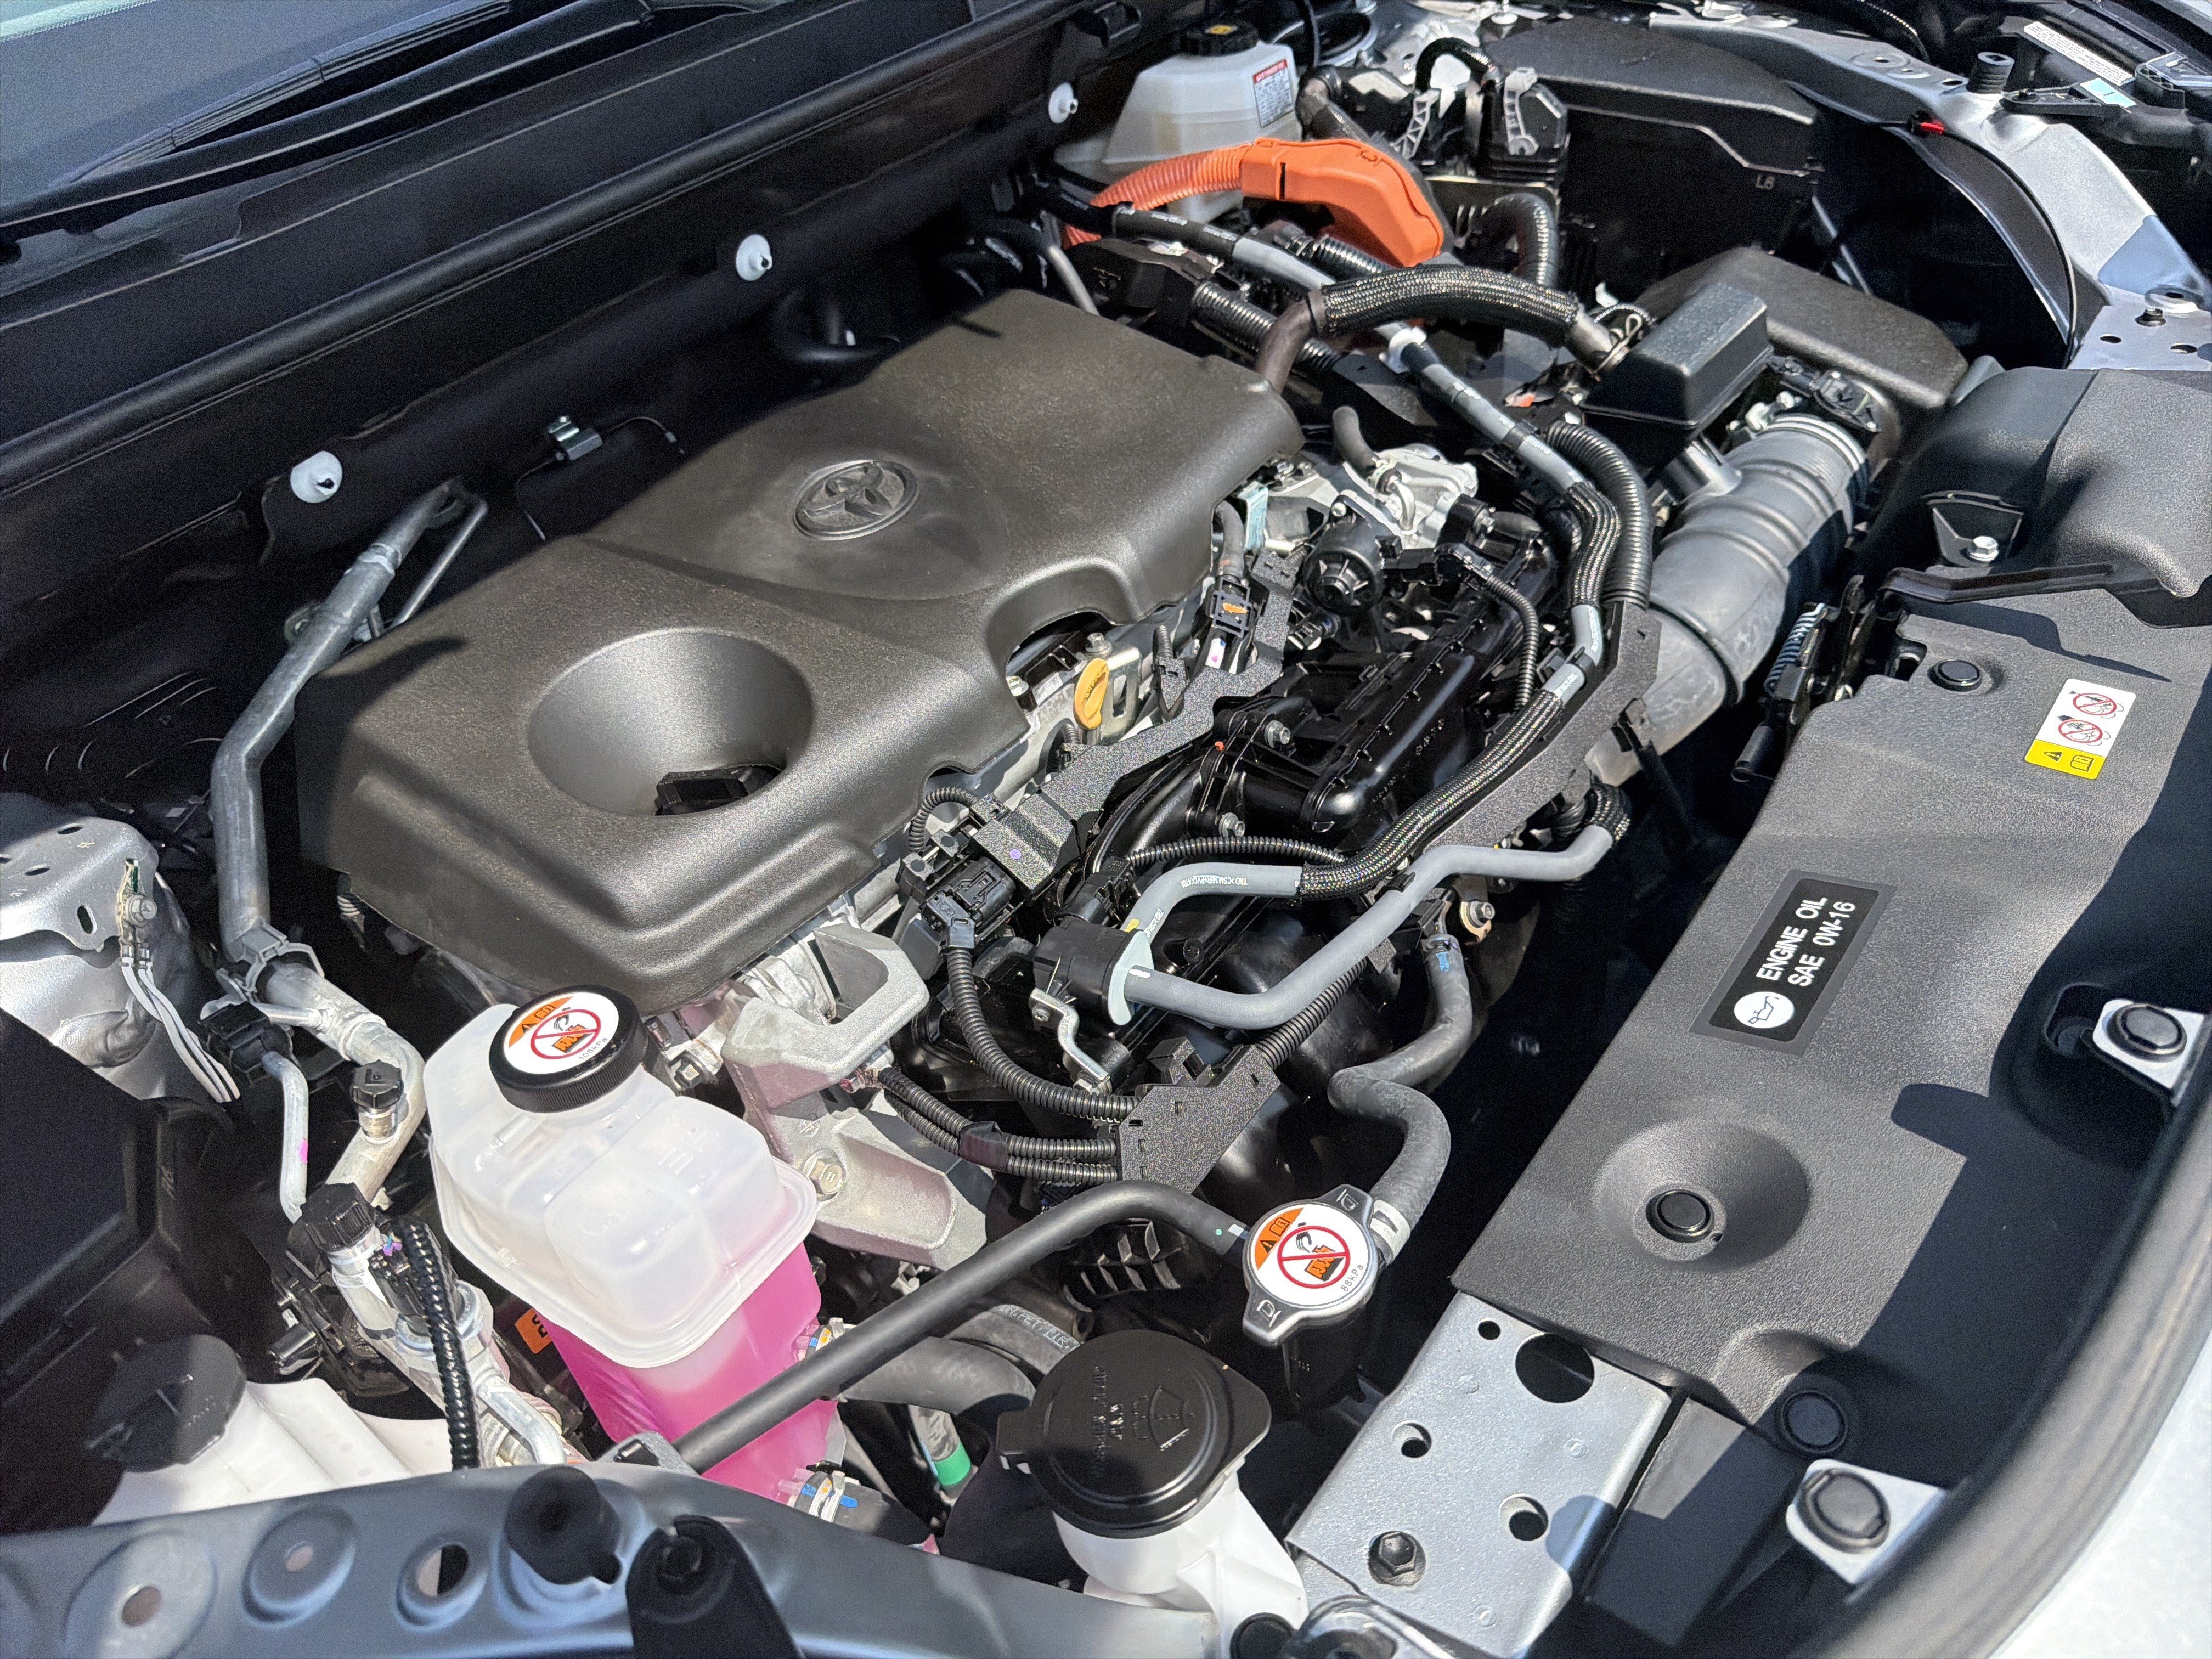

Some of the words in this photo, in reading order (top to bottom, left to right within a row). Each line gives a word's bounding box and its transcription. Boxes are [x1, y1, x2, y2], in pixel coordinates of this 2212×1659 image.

[1756, 926, 1808, 981] ENGINE
[1795, 897, 1828, 919] OIL
[1787, 954, 1825, 987] SAE
[1812, 901, 1856, 946] 0W-16
[578, 1037, 609, 1060] 108kPa
[1340, 1264, 1364, 1293] 88kPa
